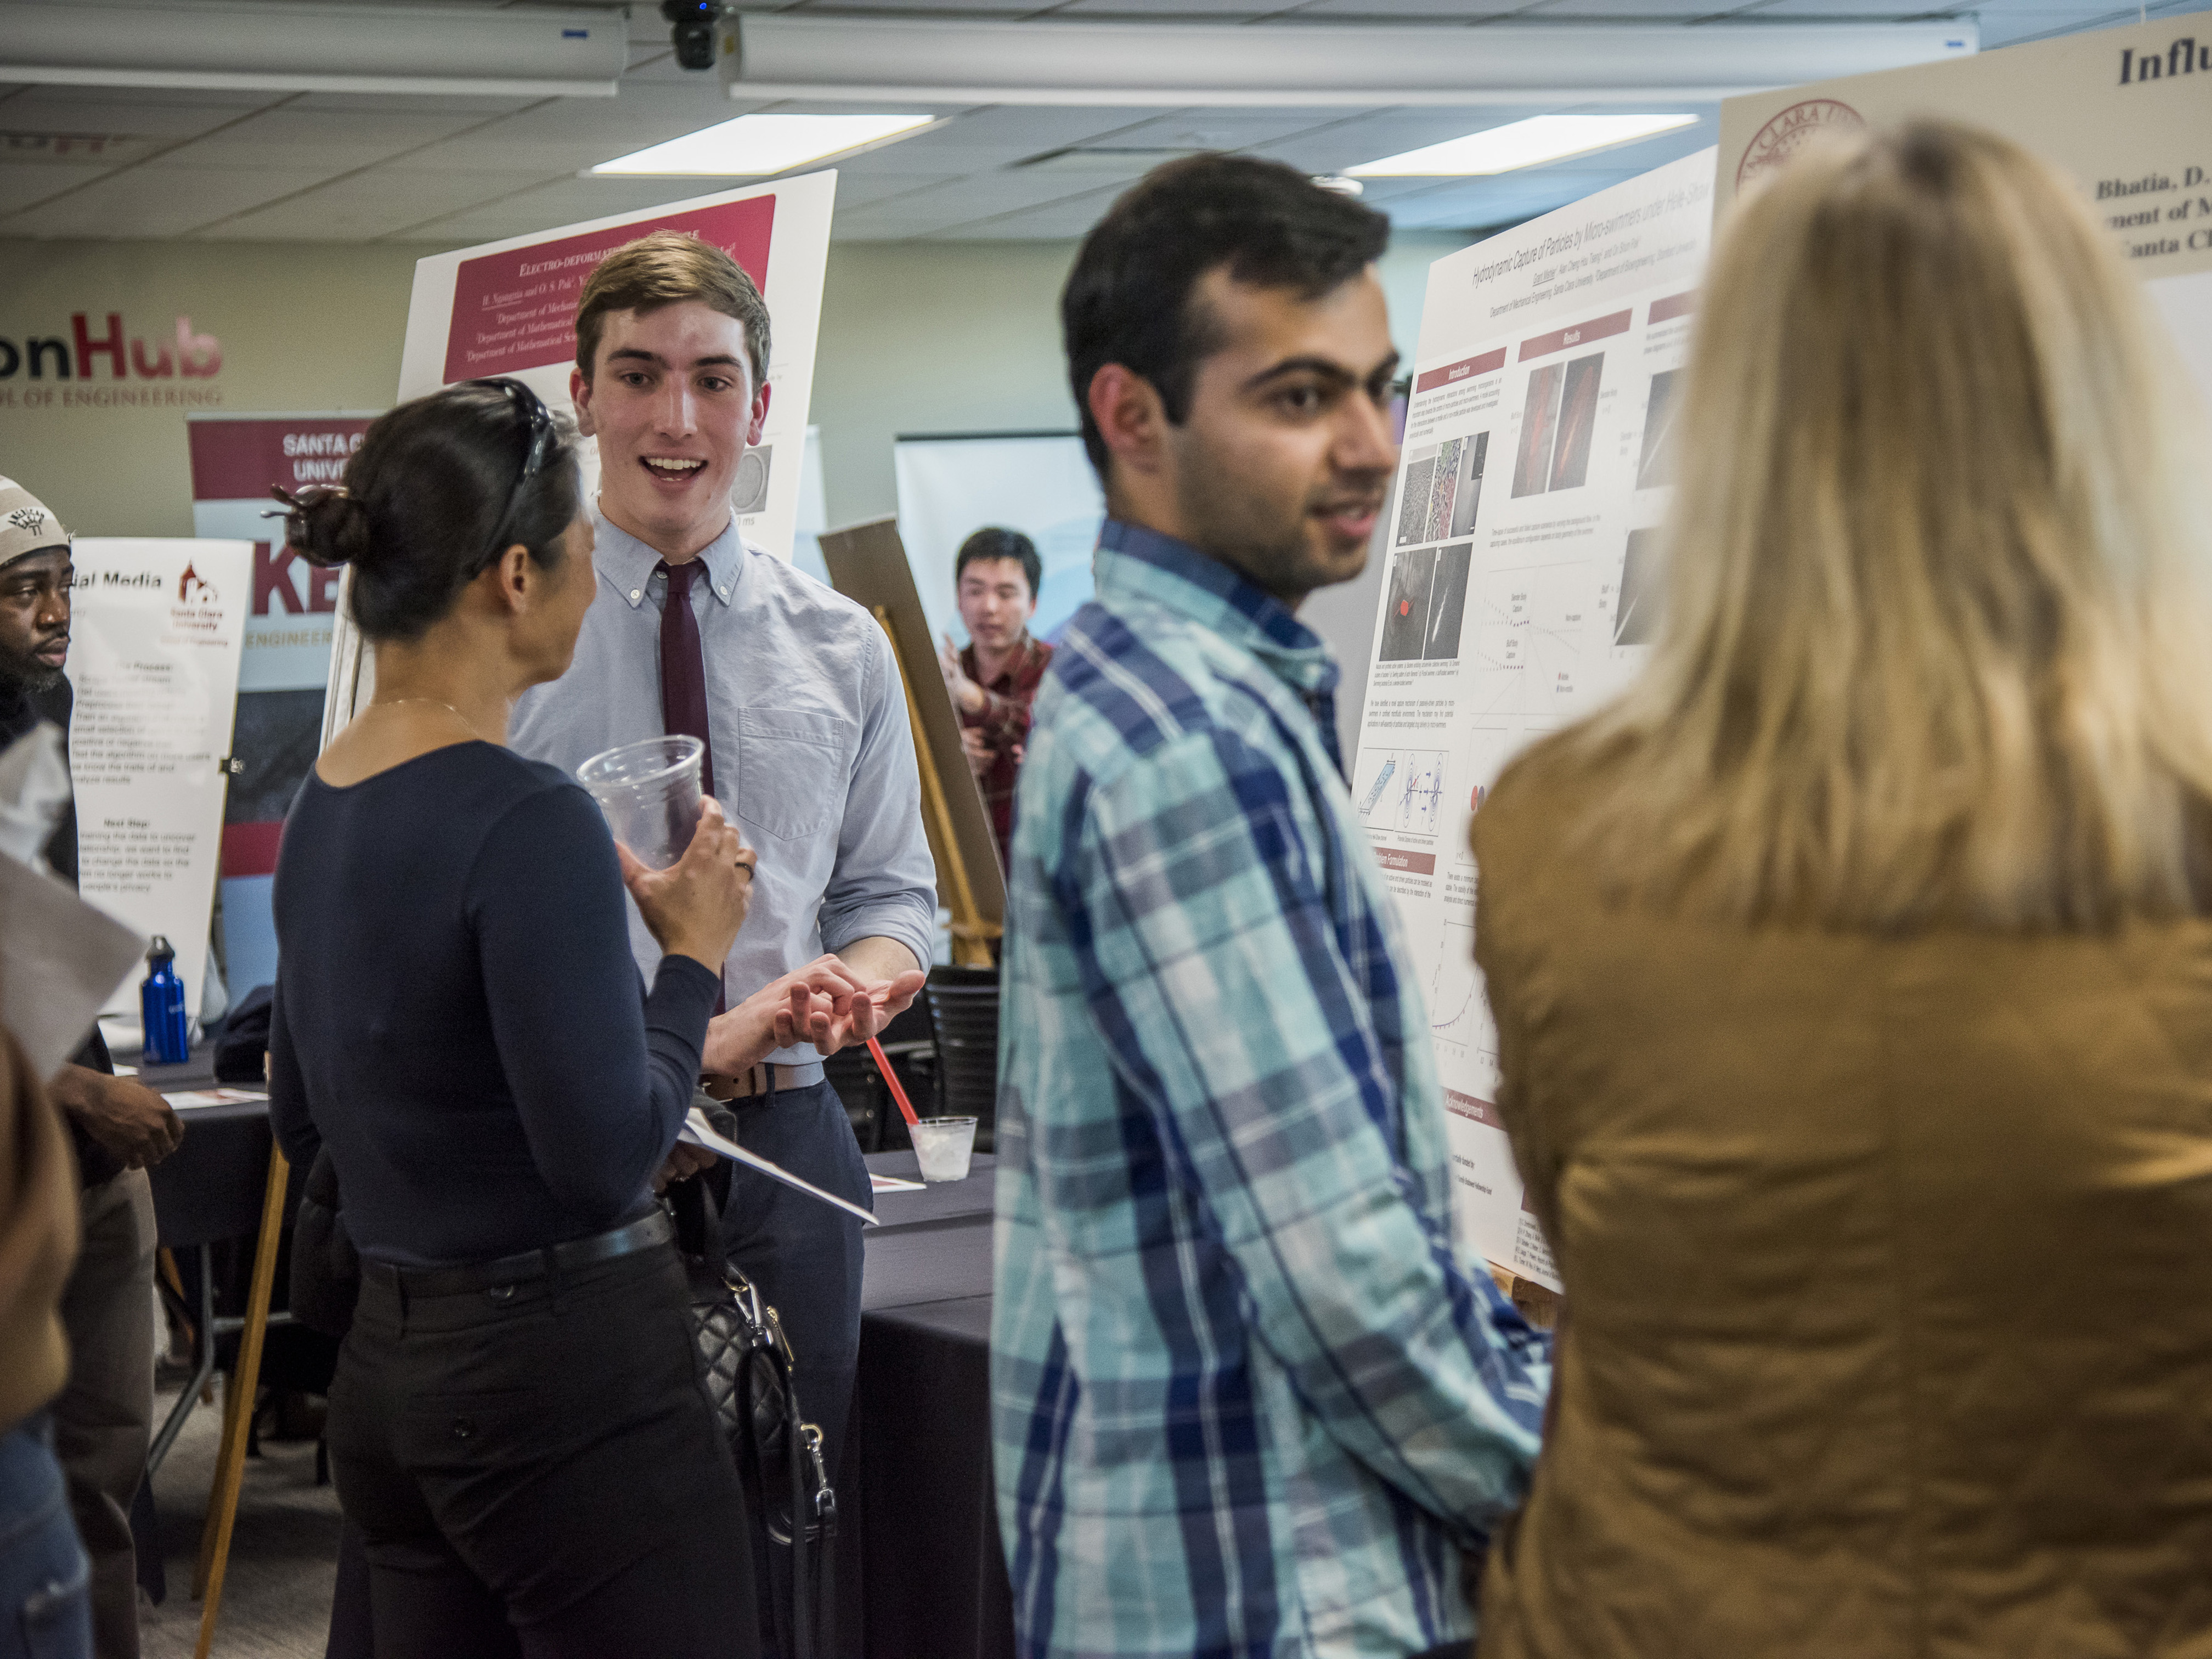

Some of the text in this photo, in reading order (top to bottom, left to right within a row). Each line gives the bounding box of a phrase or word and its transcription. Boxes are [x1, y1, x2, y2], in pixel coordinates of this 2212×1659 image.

[2095, 173, 2177, 202] Bhatia,
[2168, 199, 2194, 220] of
[1472, 254, 1513, 289] Hydrodynamic
[1513, 247, 1537, 271] Capture
[1538, 239, 1547, 260] of
[1545, 231, 1573, 257] Particles
[1574, 226, 1583, 250] by
[1583, 207, 1641, 242] Micro-swimmers
[1642, 196, 1666, 221] under
[1563, 330, 1581, 345] Results
[1448, 364, 1471, 380] Introduction
[283, 433, 346, 456] SANTA
[102, 570, 161, 589] Media
[104, 817, 124, 829] Next
[1387, 853, 1408, 867] Formulation
[1445, 1092, 1483, 1119] Acknowledgements
